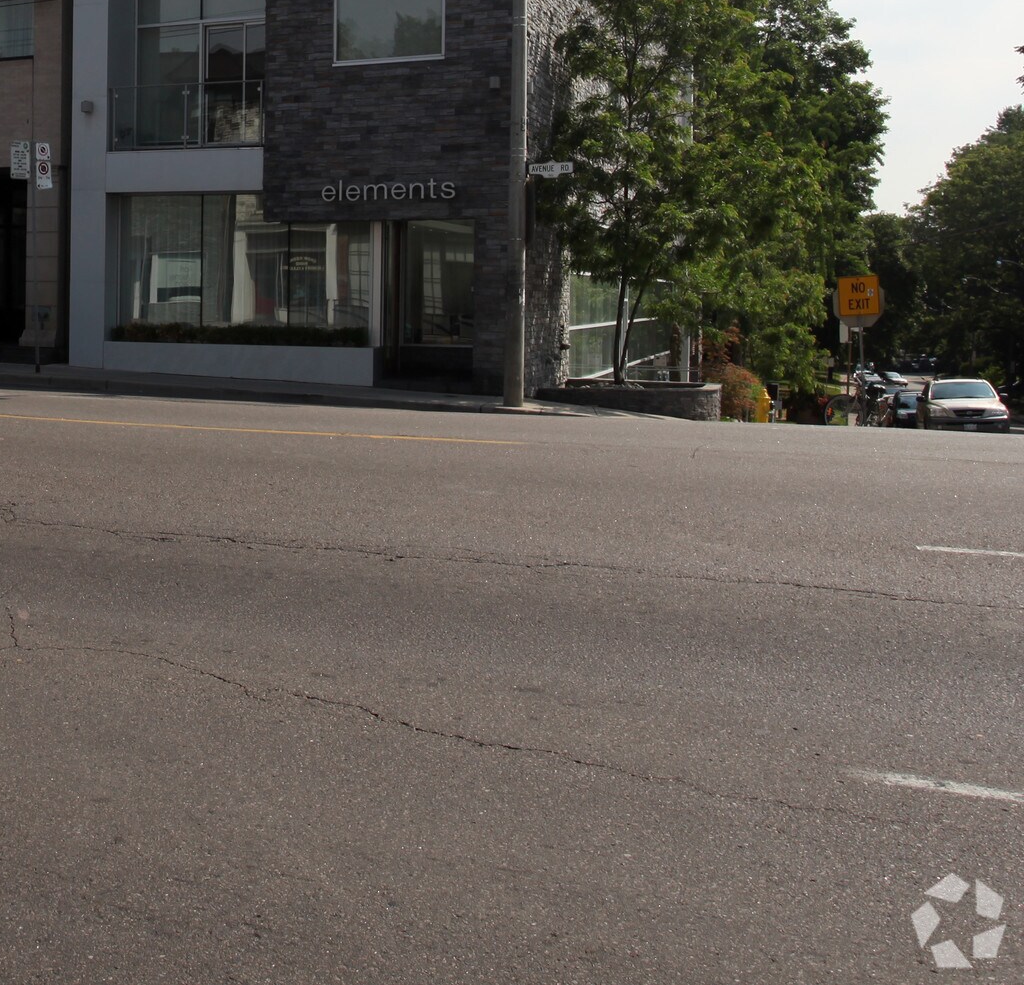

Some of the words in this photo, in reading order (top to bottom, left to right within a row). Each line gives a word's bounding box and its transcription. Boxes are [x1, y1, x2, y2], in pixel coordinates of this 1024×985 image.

[531, 164, 555, 173] AVENUE
[560, 164, 570, 172] RD
[321, 177, 456, 202] elements
[851, 282, 866, 294] NO
[848, 298, 871, 310] EXIT
